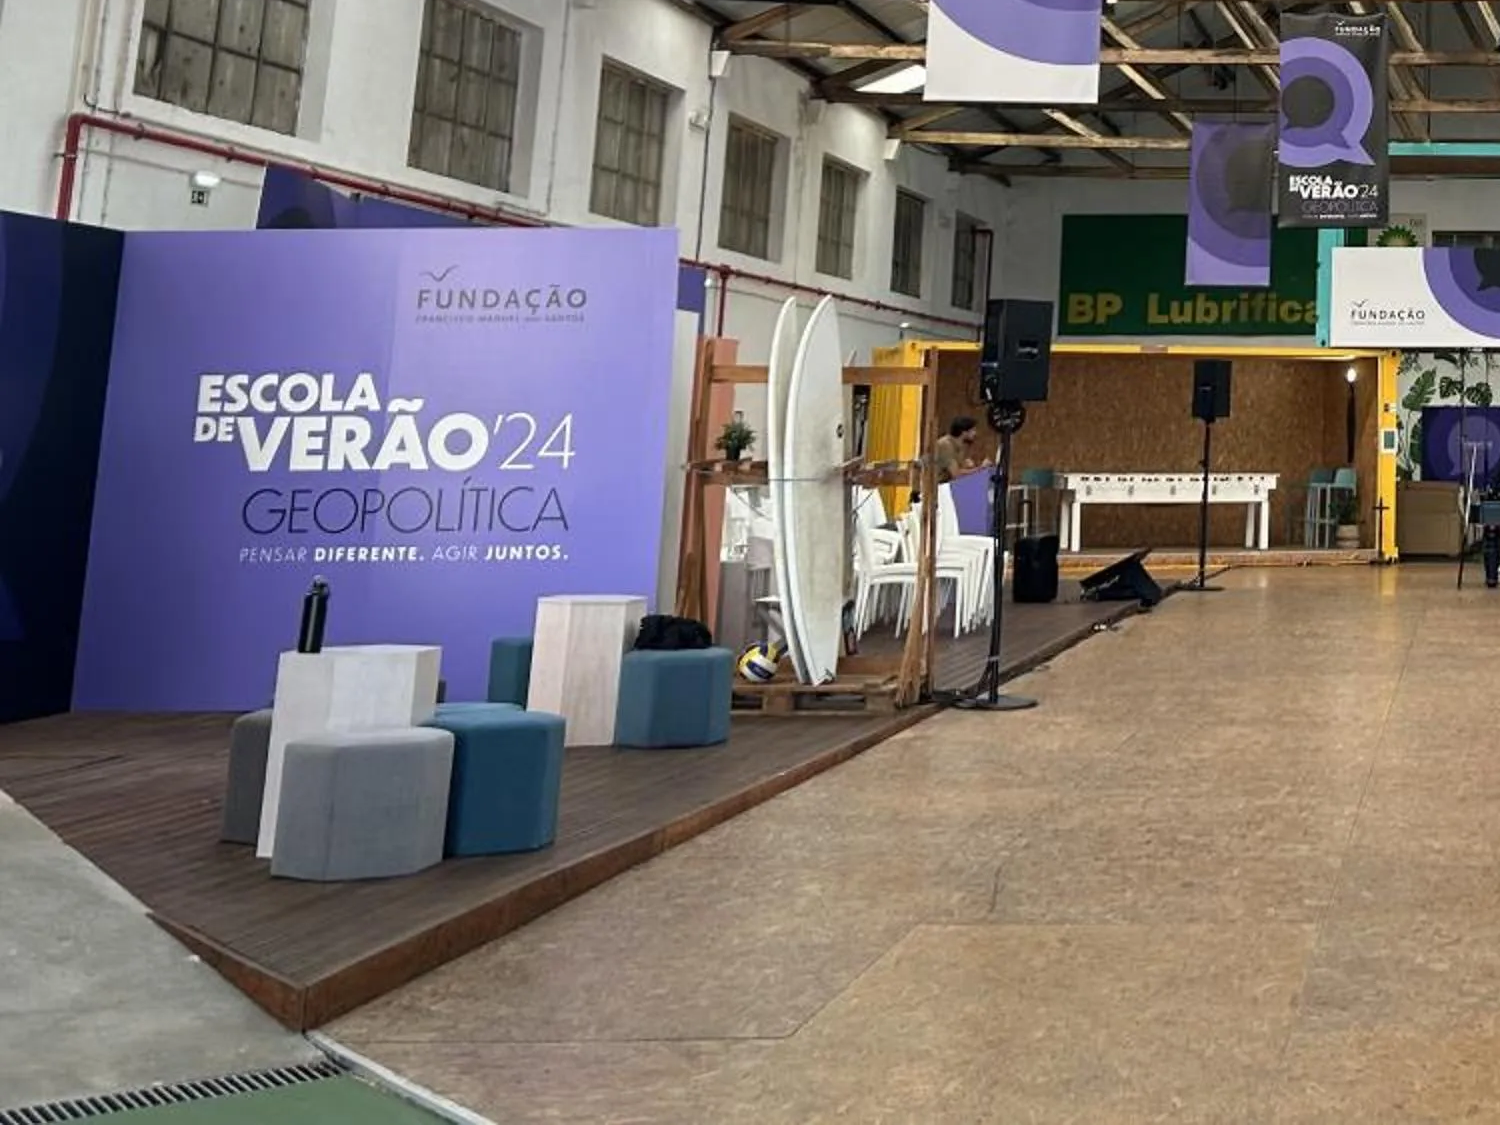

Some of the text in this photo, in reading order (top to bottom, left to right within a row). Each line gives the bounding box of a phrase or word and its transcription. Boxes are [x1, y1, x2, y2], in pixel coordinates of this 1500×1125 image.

[1300, 181, 1358, 199] VERÃO
[417, 284, 587, 315] FUNDAÇÃO
[1066, 292, 1123, 325] BP
[197, 372, 381, 413] ESCOLA
[193, 416, 234, 443] DE
[236, 398, 489, 472] VERÃO
[241, 476, 570, 535] GEOPOLÍTICA
[239, 544, 570, 562] PENSAR DIFERENTE. AGIR JUNTOS.
